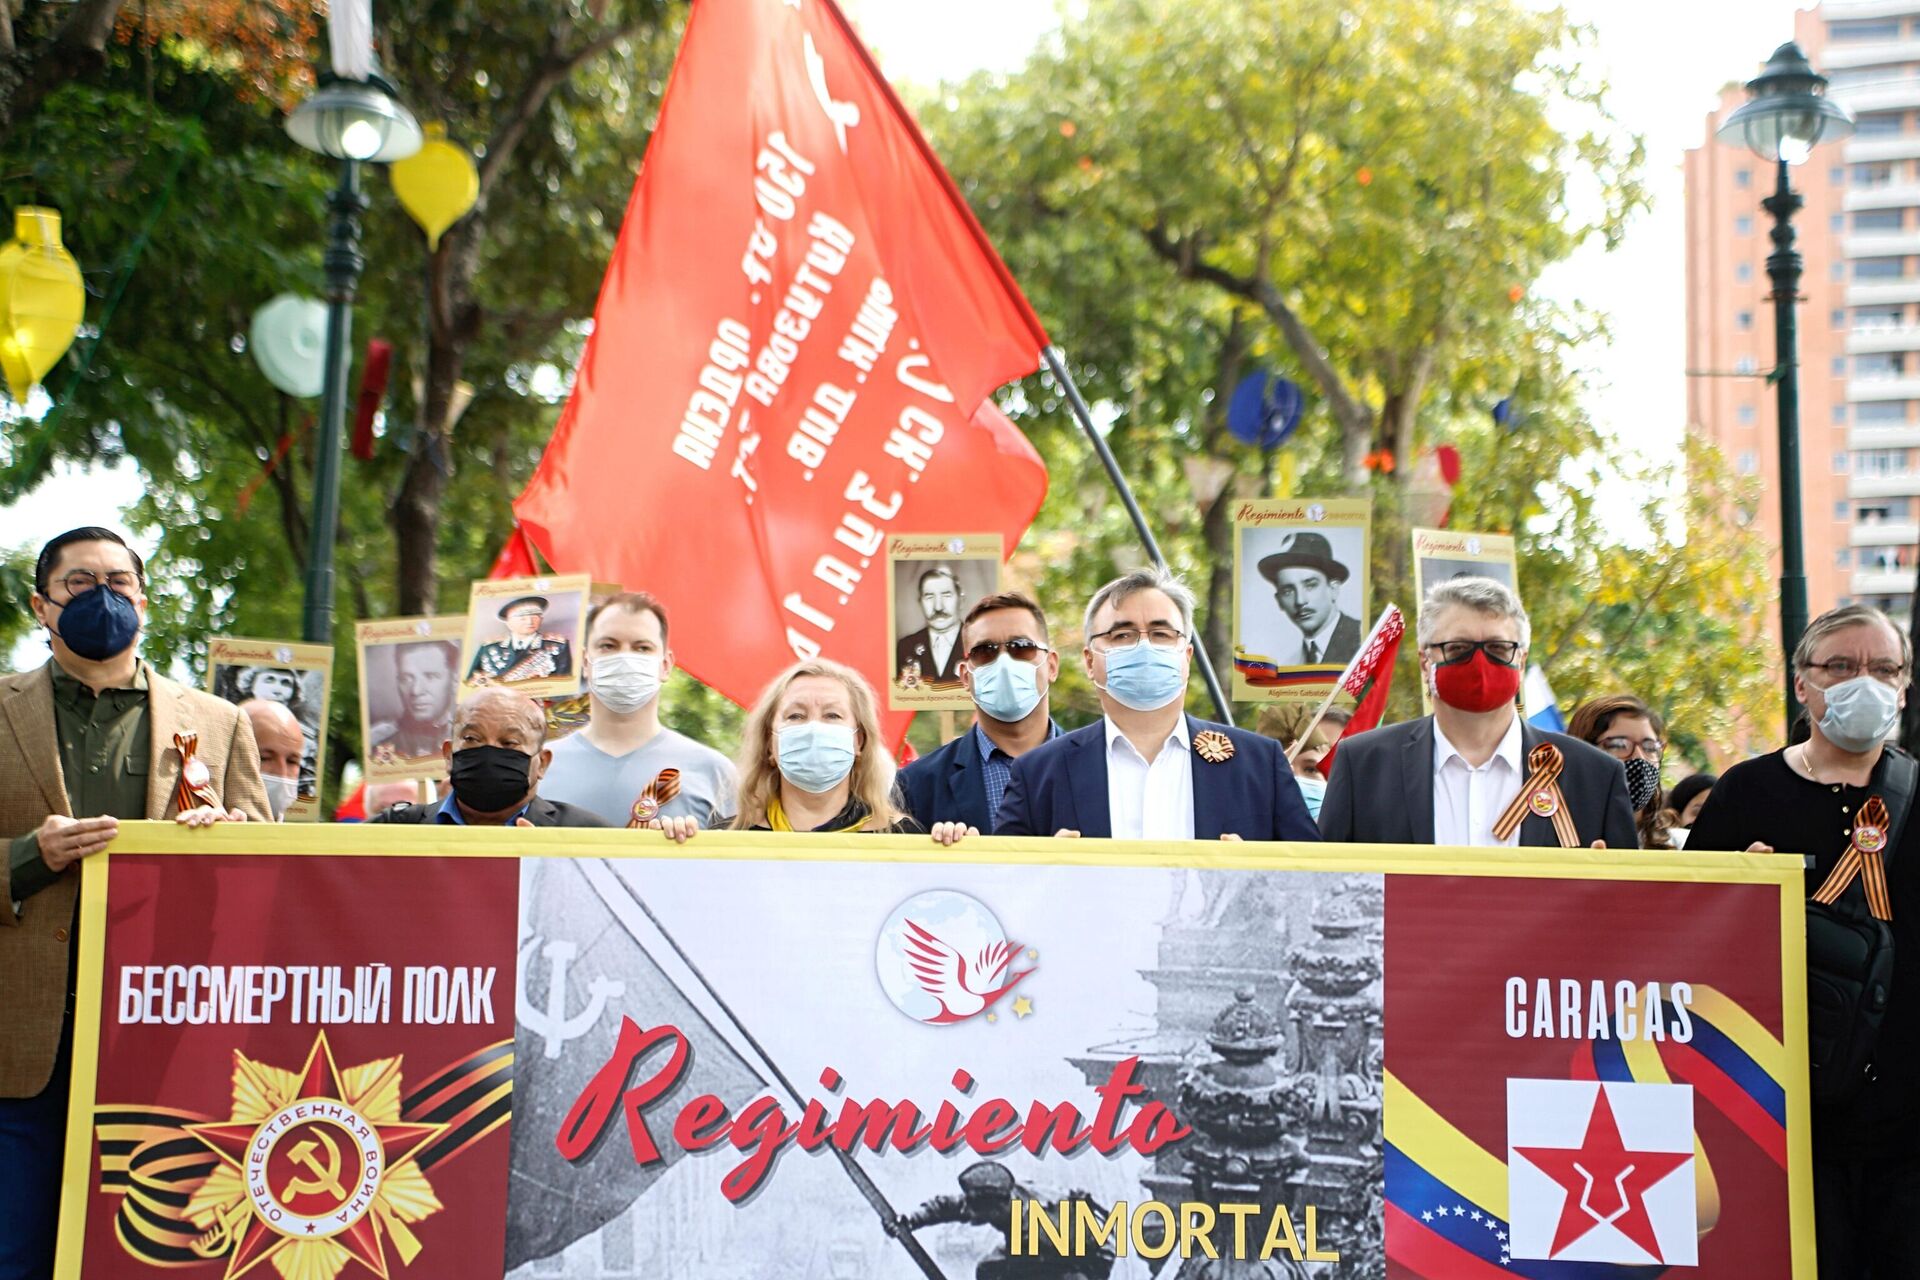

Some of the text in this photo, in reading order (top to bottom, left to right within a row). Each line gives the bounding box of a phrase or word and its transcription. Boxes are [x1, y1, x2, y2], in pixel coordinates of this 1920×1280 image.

[1236, 502, 1305, 527] Regimiento
[118, 962, 497, 1025] БЕССМЕРТНЫЙ ПОЛК
[1505, 975, 1694, 1044] CARACAS
[554, 1014, 1196, 1204] Regimiento
[250, 1104, 379, 1224] ОТЕЧЕСТВЕННАЯ ВОЙНА
[1009, 1198, 1340, 1263] INMORTAL
